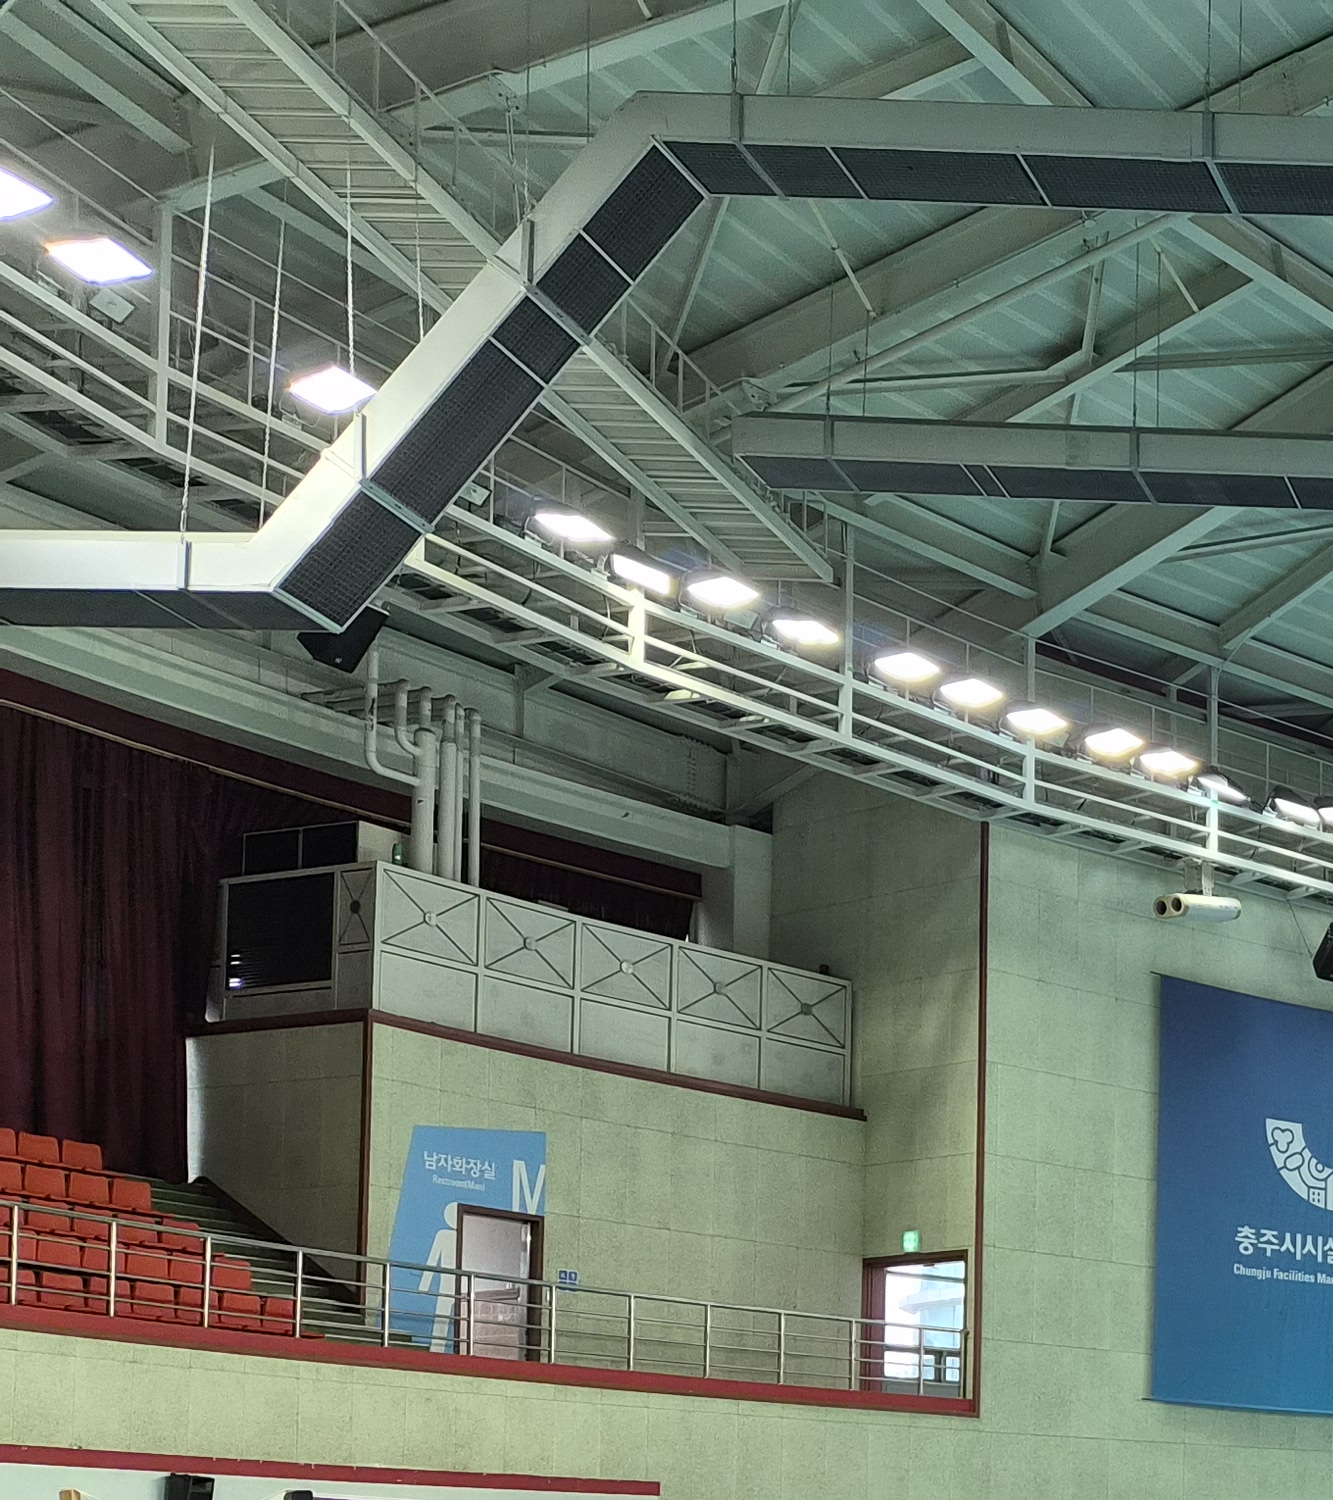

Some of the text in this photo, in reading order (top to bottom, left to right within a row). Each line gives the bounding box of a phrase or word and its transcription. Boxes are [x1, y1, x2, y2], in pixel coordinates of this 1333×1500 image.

[423, 1151, 497, 1180] 남자화장실
[1233, 1263, 1272, 1280] Chungju
[1273, 1268, 1315, 1283] Facilities
